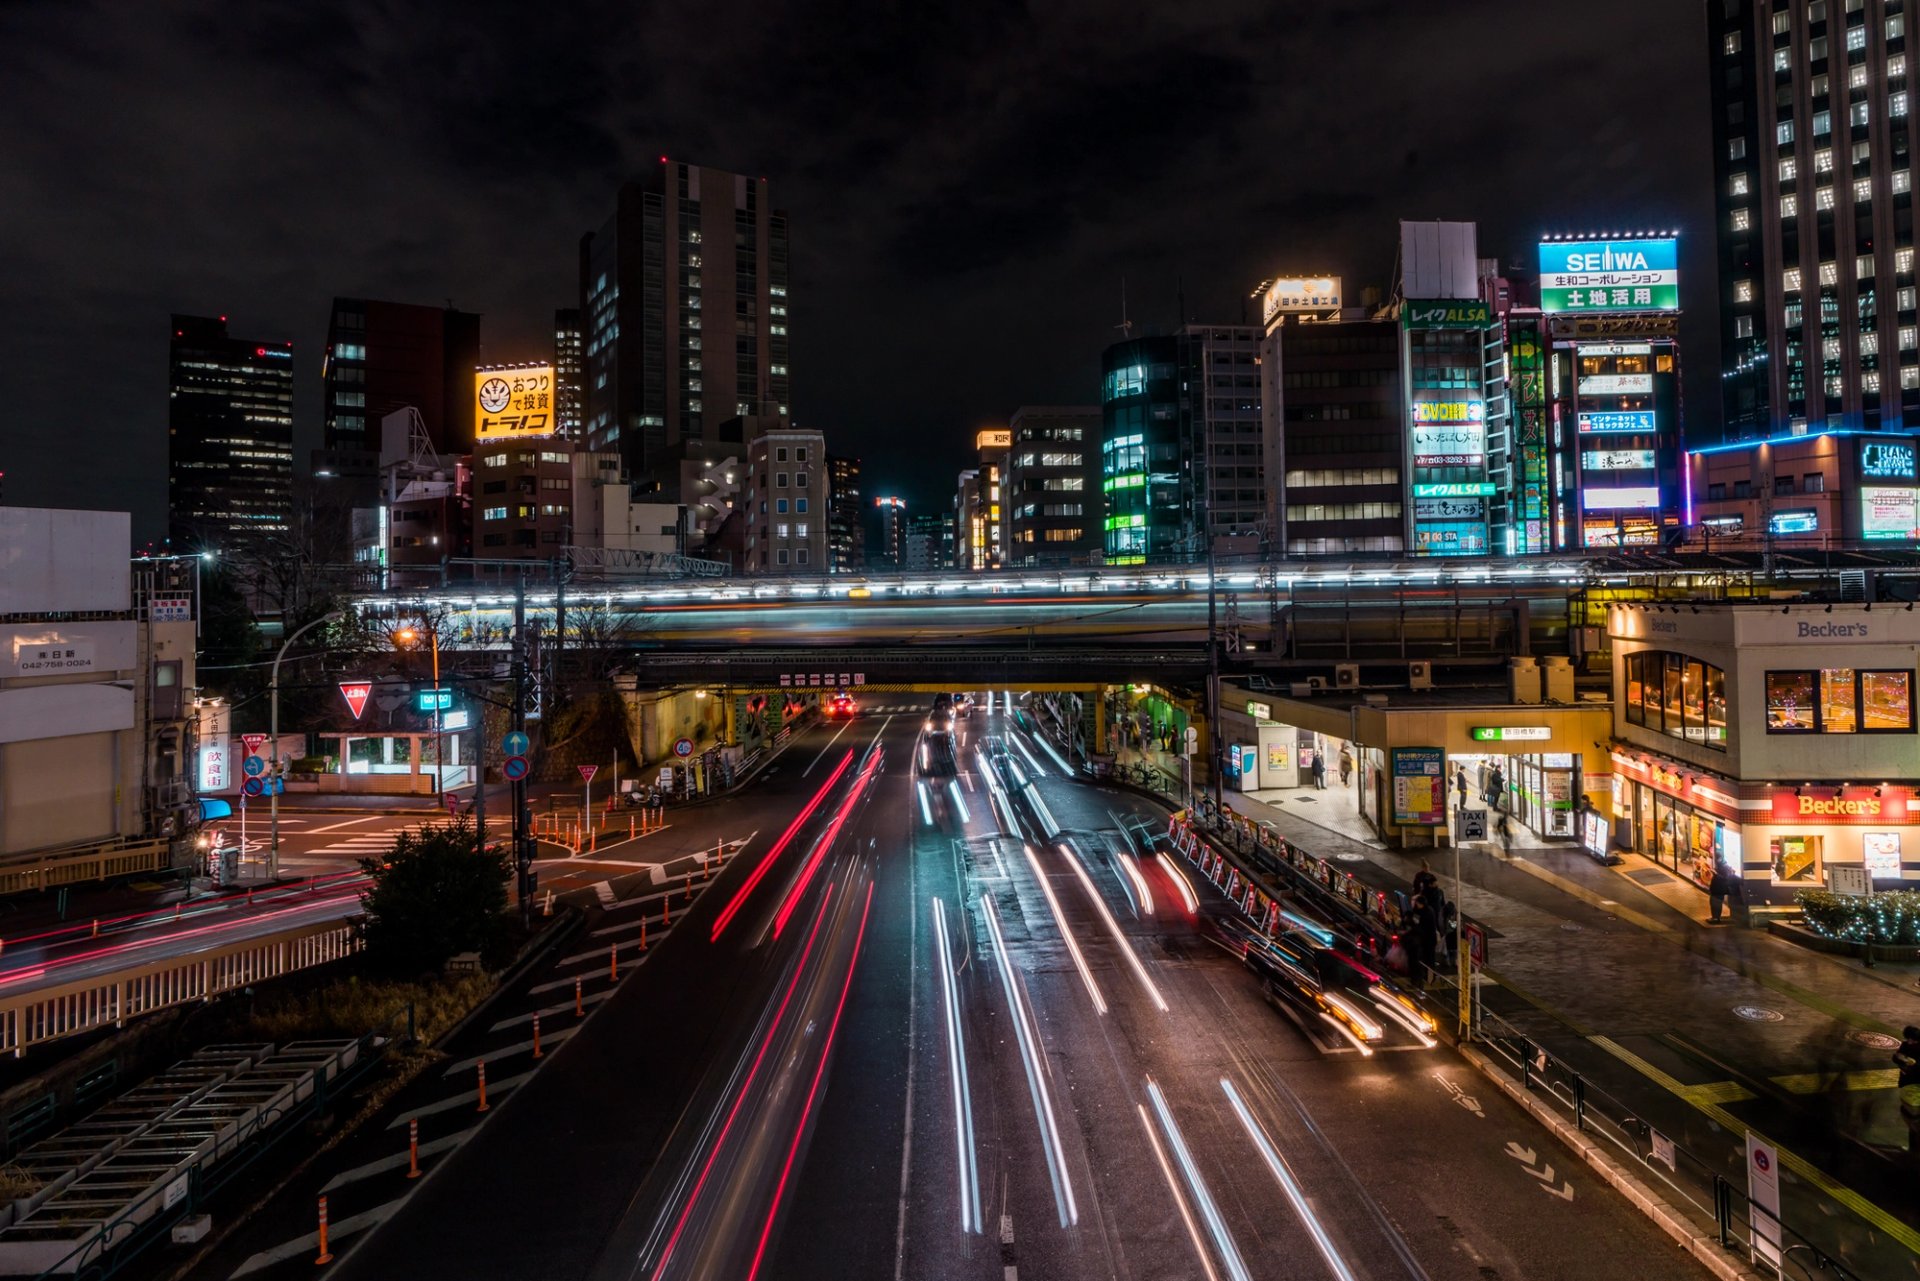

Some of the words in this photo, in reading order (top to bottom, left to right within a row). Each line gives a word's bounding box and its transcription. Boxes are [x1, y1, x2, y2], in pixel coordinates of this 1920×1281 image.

[1566, 244, 1648, 271] SEIWA
[1555, 274, 1662, 286] 生和コーポレーション
[1567, 288, 1651, 307] 土地活用
[1411, 309, 1486, 321] レイクALSA
[513, 374, 549, 393] おつり
[513, 393, 549, 410] で投資
[481, 414, 548, 432] トラノコ
[1592, 415, 1636, 423] インターネット
[1419, 484, 1480, 494] レイクALSA
[1651, 619, 1677, 633] Becker's
[1797, 621, 1868, 637] Becker's
[22, 659, 92, 670] 042-758-0024
[1481, 729, 1495, 738] JR
[207, 751, 222, 787] 飲食街
[1798, 795, 1880, 815] Becker's
[1462, 812, 1485, 820] TAXI
